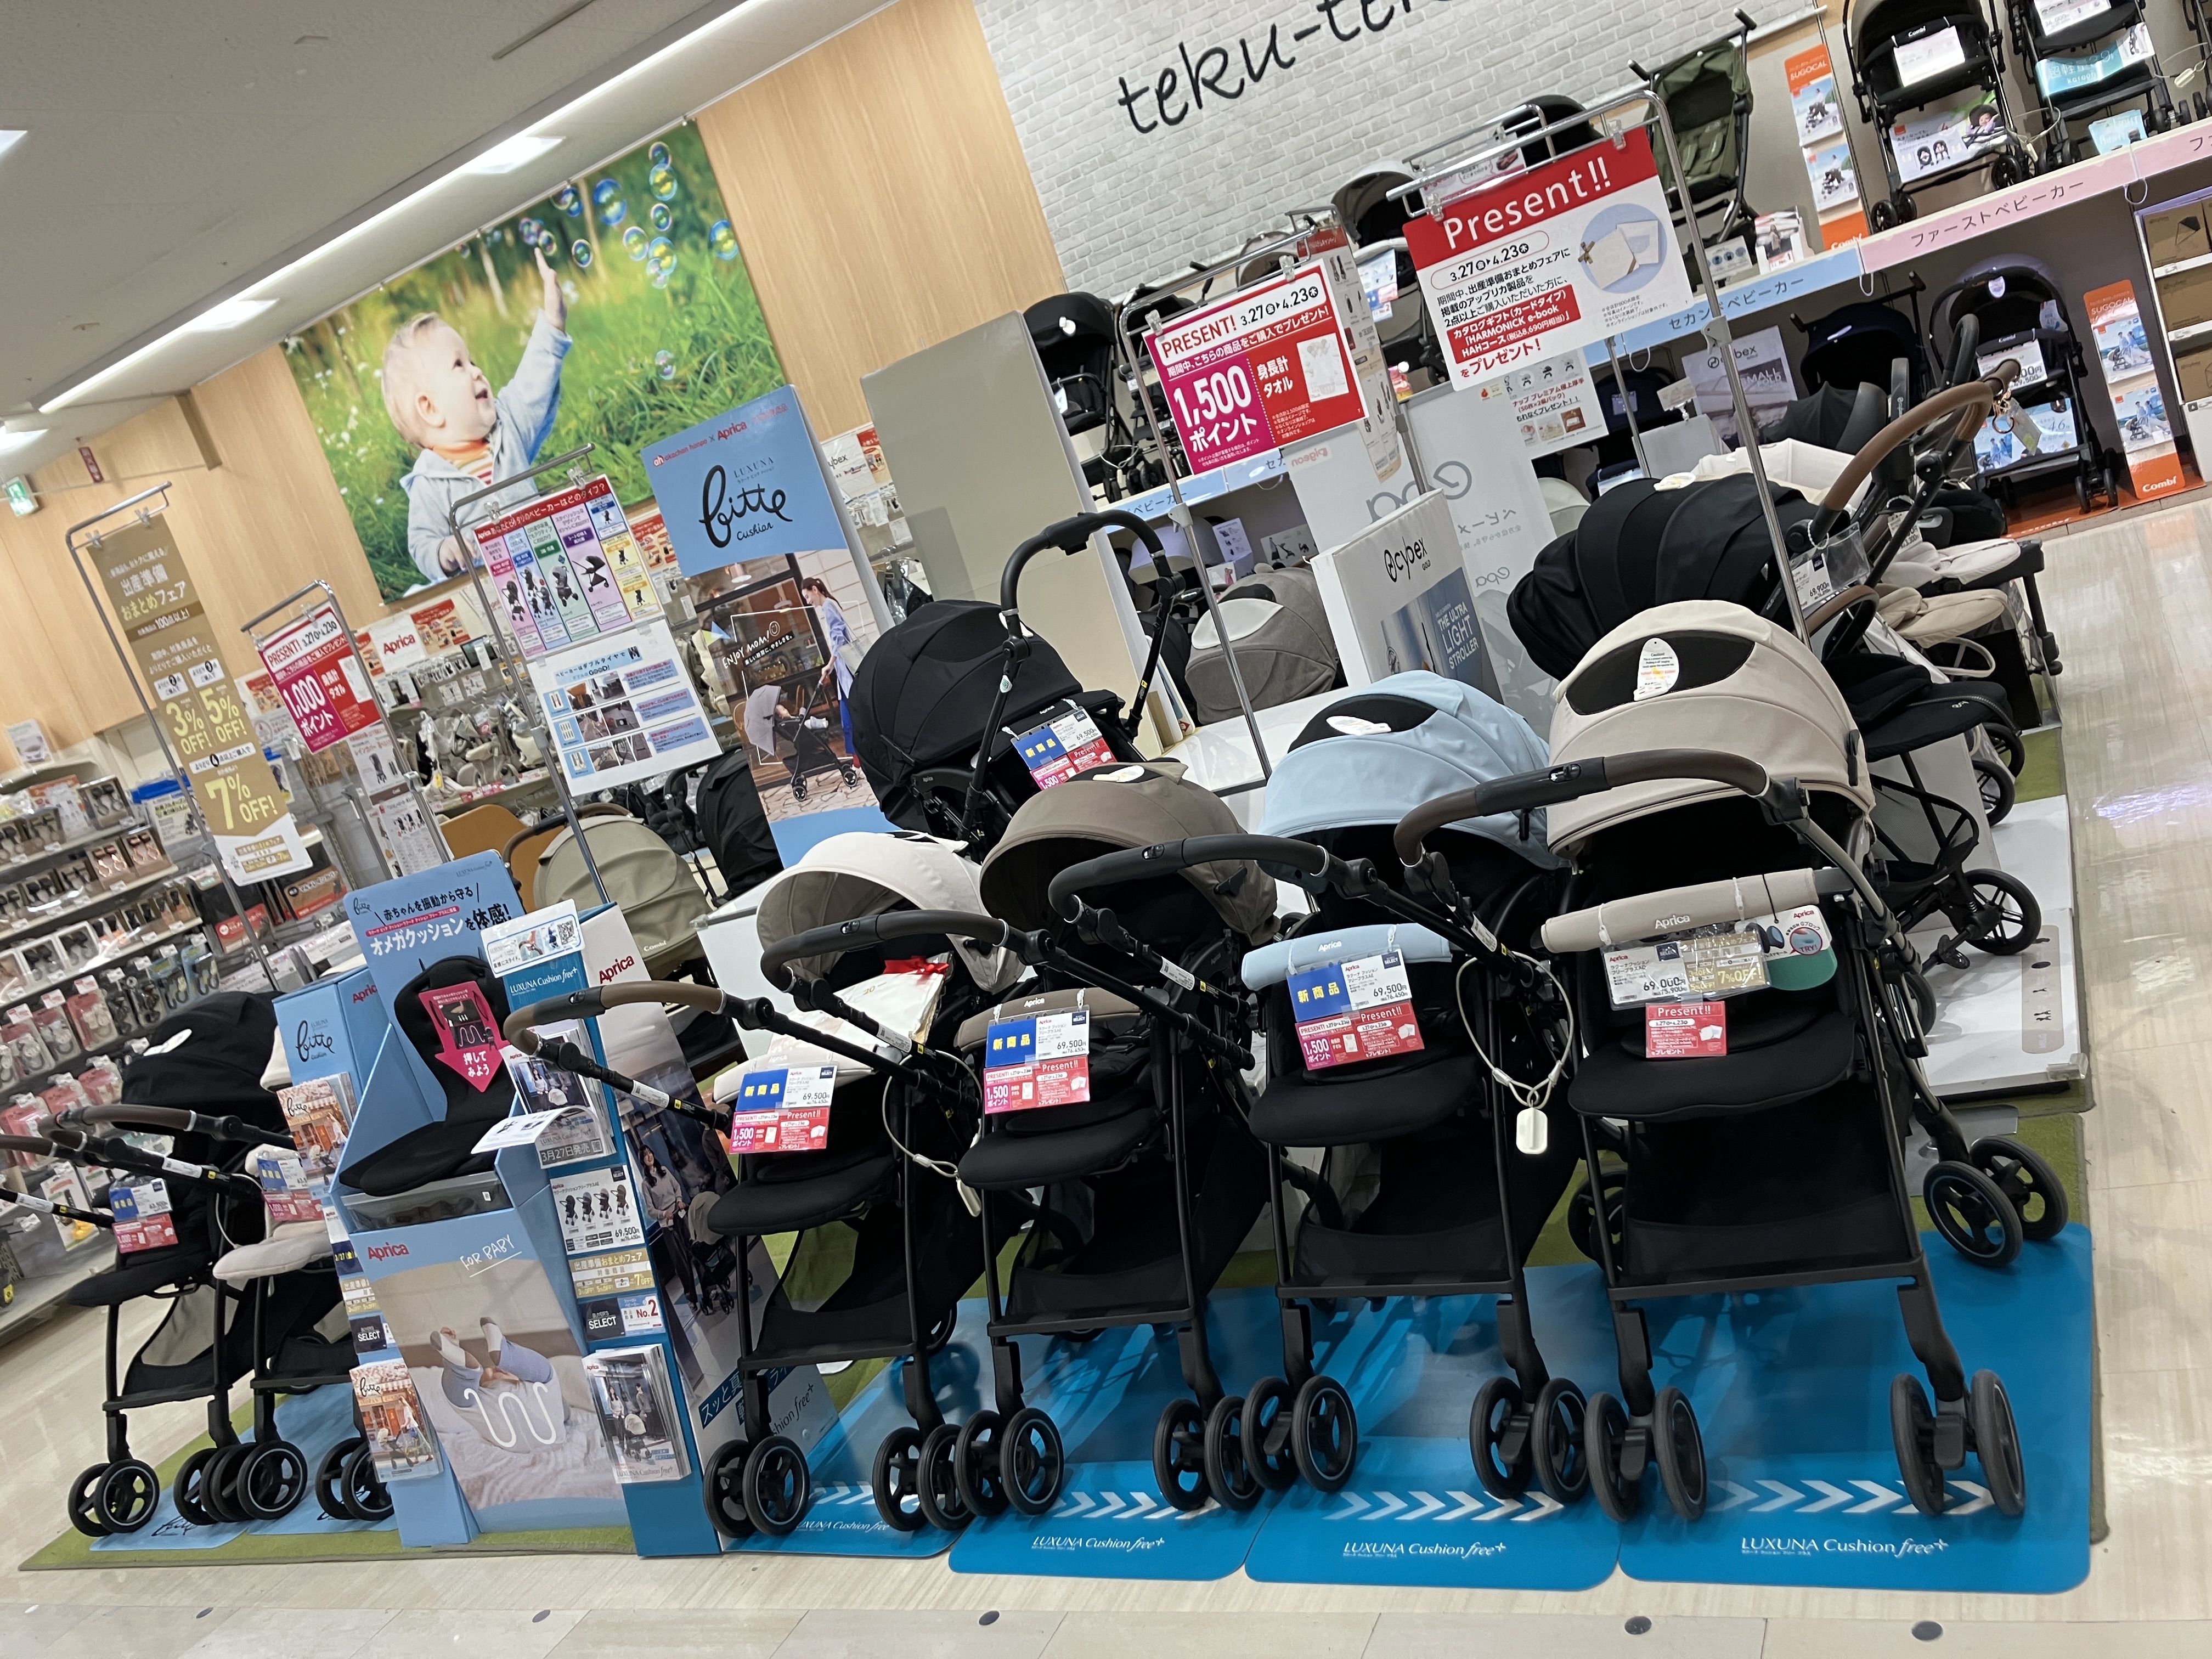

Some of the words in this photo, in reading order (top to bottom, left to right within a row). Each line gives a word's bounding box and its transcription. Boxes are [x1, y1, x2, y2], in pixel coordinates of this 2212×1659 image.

[1118, 0, 1413, 134] teku-te
[1790, 60, 1827, 81] SUGOCAL
[1443, 156, 1612, 250] Present!!
[1911, 182, 2085, 248] ファーストベビーカー
[1437, 247, 1571, 306] 期間中、出産準備おまとめフェアに
[1441, 275, 1534, 317] 掲載のアップリカ製品を
[1527, 306, 1559, 325] e-book
[1161, 315, 1237, 358] PRESENT!
[1257, 356, 1289, 380] 身長計
[1173, 364, 1252, 429] 1,500
[1263, 375, 1293, 399] タオル
[717, 421, 747, 441] Aprica
[1189, 413, 1257, 453] ポイント
[2143, 476, 2177, 493] Combi
[1396, 537, 1429, 580] cybex
[121, 580, 186, 622] おまとめフェア
[1437, 614, 1451, 631] THE
[1449, 601, 1468, 622] ULTRA
[1442, 614, 1472, 654] LIGHT
[267, 639, 301, 667] PRESENT!
[384, 634, 416, 654] Aprica
[1448, 637, 1479, 670] STROLLER
[722, 645, 745, 669] ENJOY
[199, 687, 240, 725] 5%
[283, 674, 326, 720] 1,000
[166, 701, 205, 737] 3%
[300, 709, 334, 737] ポイント
[216, 719, 247, 743] OFF!
[180, 731, 212, 755] OFF!
[205, 773, 251, 830] 7%
[239, 795, 278, 823] OFF!
[383, 886, 474, 921] 赤ちゃんを振動から守る
[1655, 912, 1691, 930] Aprica
[1793, 909, 1815, 919] Aprica
[370, 903, 512, 956] オメガクッションを体感!
[644, 940, 667, 952] Combi
[1318, 940, 1342, 952] Aprica
[1799, 944, 1818, 953] TRY!
[1345, 964, 1359, 972] Aprica
[1609, 954, 1629, 963] Aprica
[599, 955, 635, 985] Aprica
[510, 979, 538, 995] LUXUNA
[537, 973, 562, 988] Cushion
[1373, 983, 1408, 997] 69,500円
[1024, 997, 1045, 1008] Aprica
[1657, 1004, 1712, 1018] Present!!
[1361, 1006, 1403, 1023] Present!!
[1057, 1039, 1086, 1050] 69,500円
[1304, 1037, 1330, 1055] 1,500
[463, 1050, 487, 1065] 押して
[1042, 1059, 1079, 1073] Present!!
[1308, 1053, 1331, 1063] ポイント
[468, 1064, 490, 1078] みよう
[803, 1092, 830, 1101] 69,500円
[986, 1085, 1008, 1101] 1,500
[987, 1098, 1008, 1107] ポイント
[787, 1109, 821, 1120] Present!!
[733, 1127, 754, 1141] 1,500
[541, 1144, 591, 1163] 3月27日発売
[614, 1226, 640, 1238] 69,500円
[368, 1242, 409, 1261] Aprica
[483, 1234, 515, 1260] BABY
[589, 1316, 617, 1330] SELECT
[358, 1330, 381, 1342] SELECT
[797, 1521, 832, 1530] UXUNA
[833, 1521, 870, 1530] Cushion
[1033, 1536, 1083, 1547] LUXUNA
[1086, 1537, 1131, 1548] Cushion
[1344, 1542, 1405, 1554] LUXUNA
[1408, 1543, 1464, 1555] Cushion
[1741, 1537, 1819, 1551] LUXUNA
[1823, 1538, 1897, 1554] Cushion
